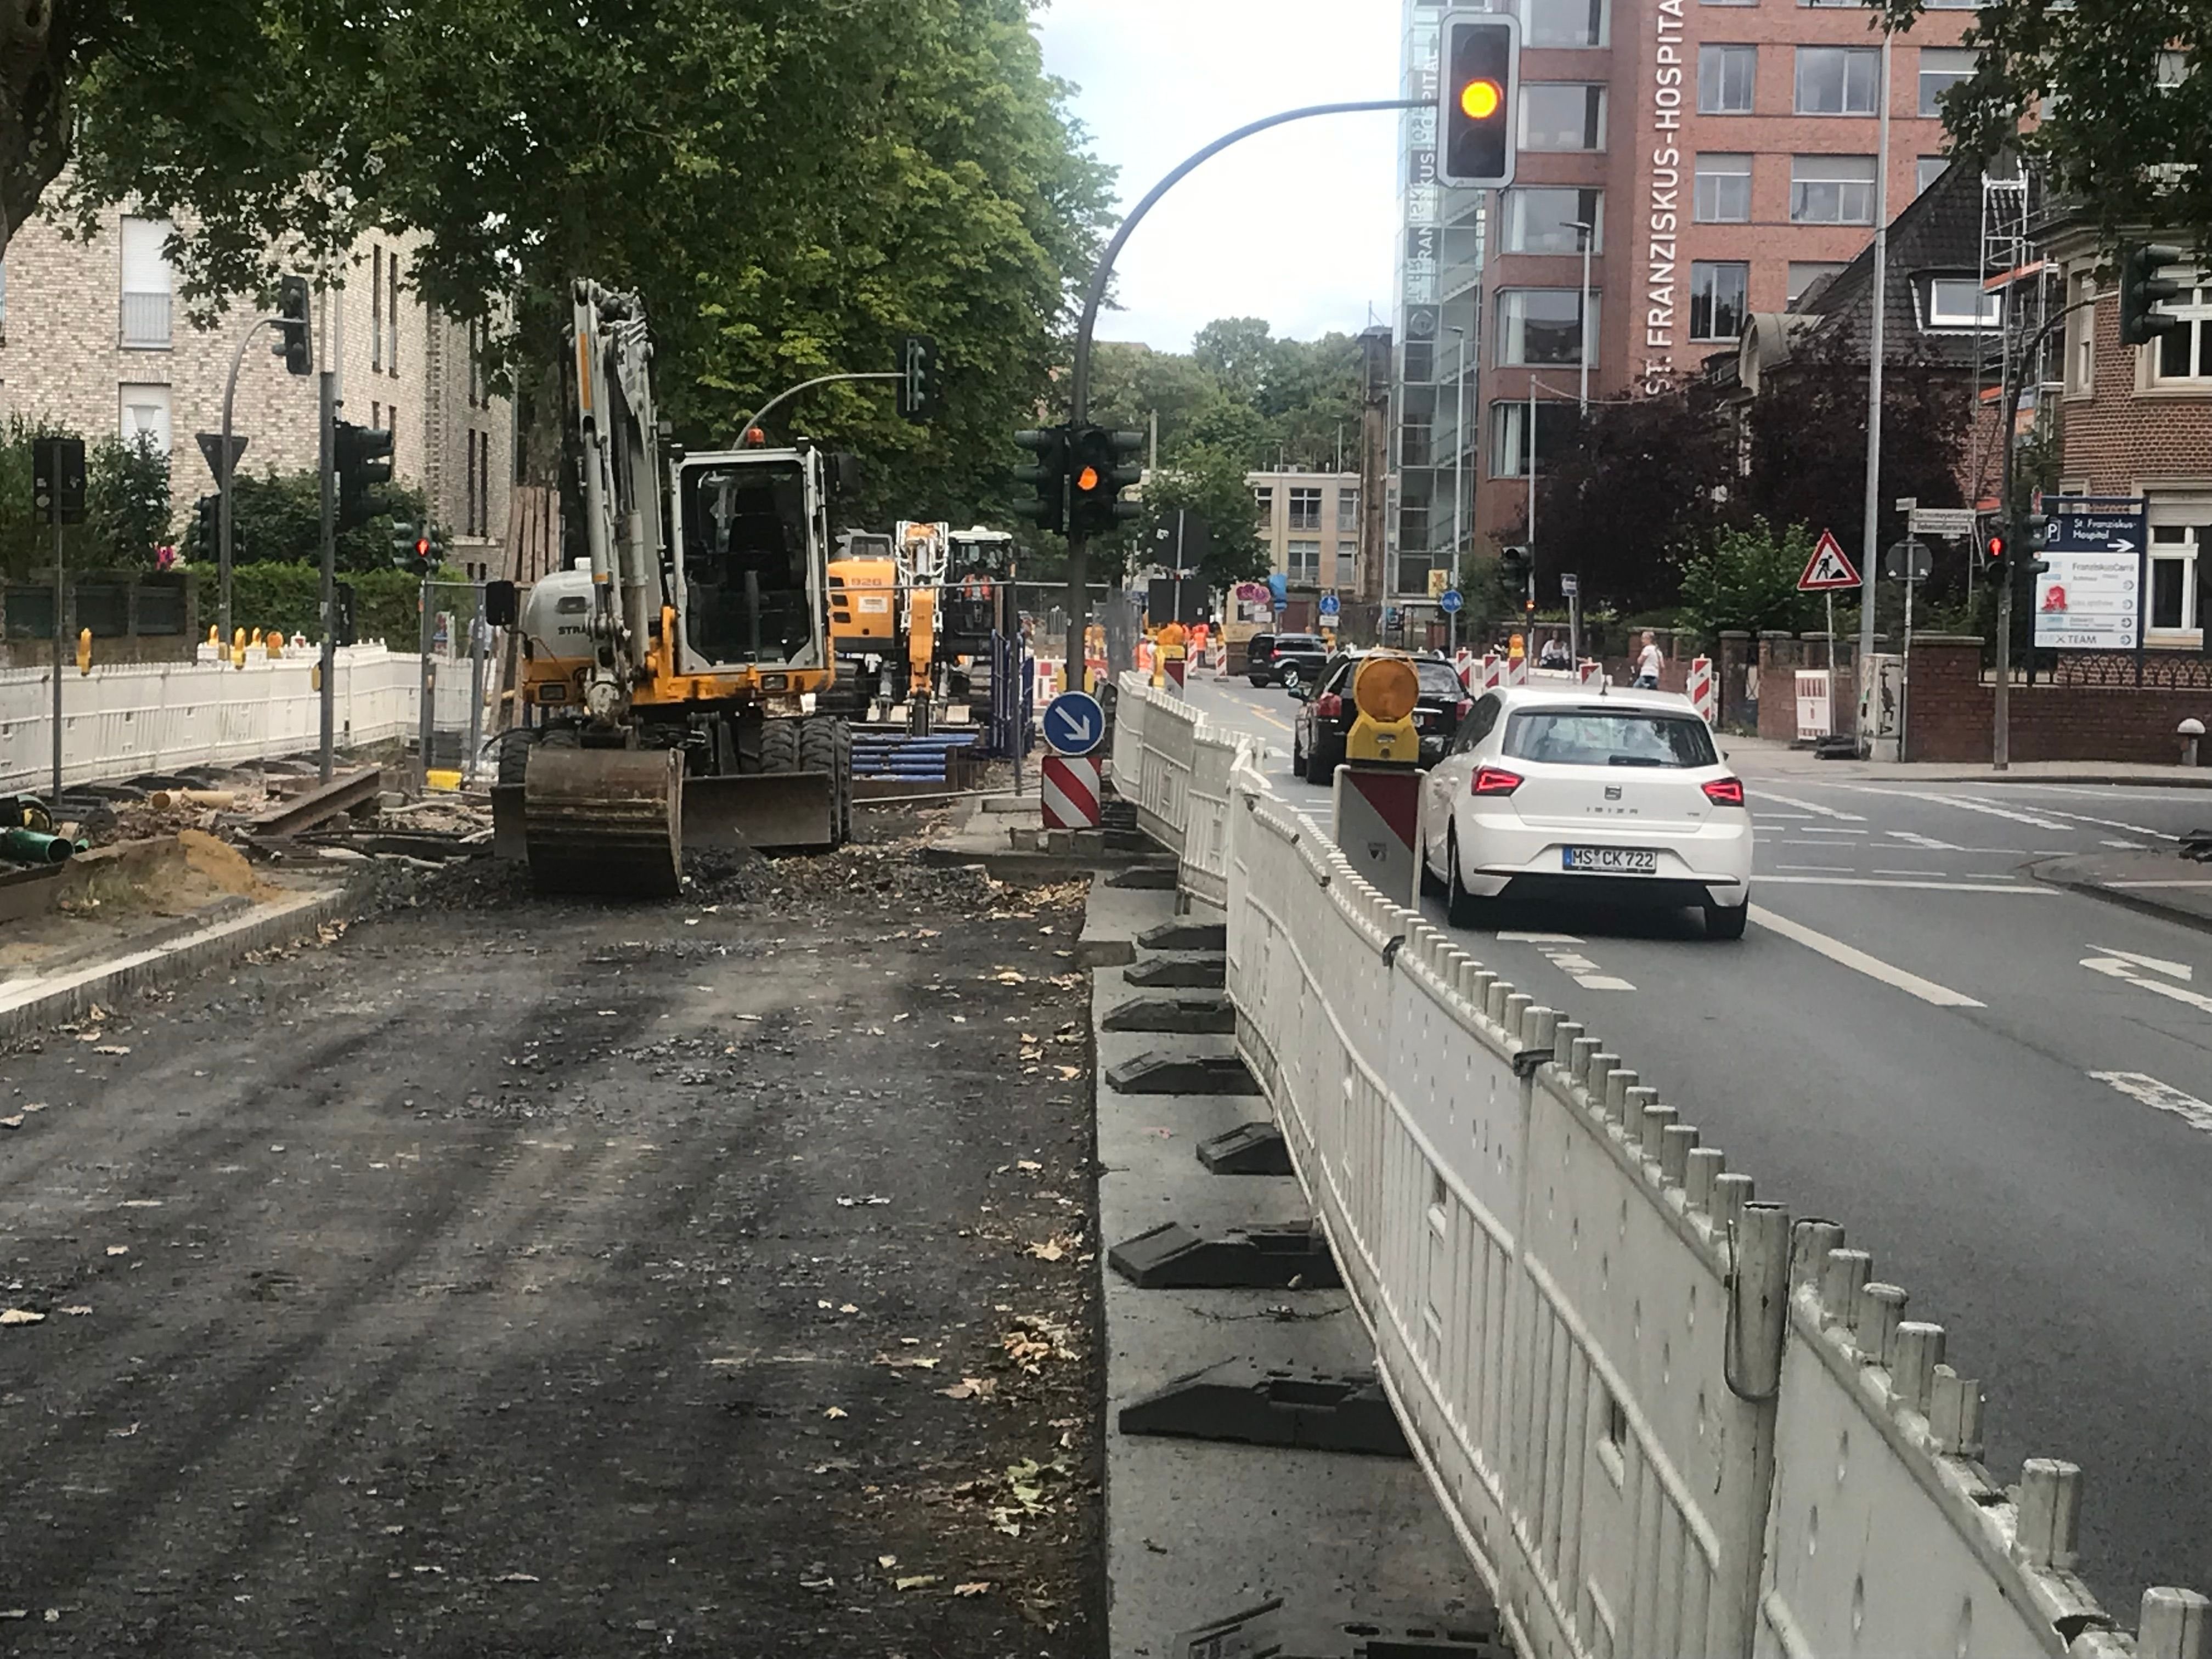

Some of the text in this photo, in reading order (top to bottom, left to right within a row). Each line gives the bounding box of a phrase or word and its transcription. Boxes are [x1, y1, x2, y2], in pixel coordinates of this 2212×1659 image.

[2072, 530, 2109, 541] Hospital
[2068, 635, 2097, 644] TEAM
[1572, 850, 1654, 867] MS CK 722
